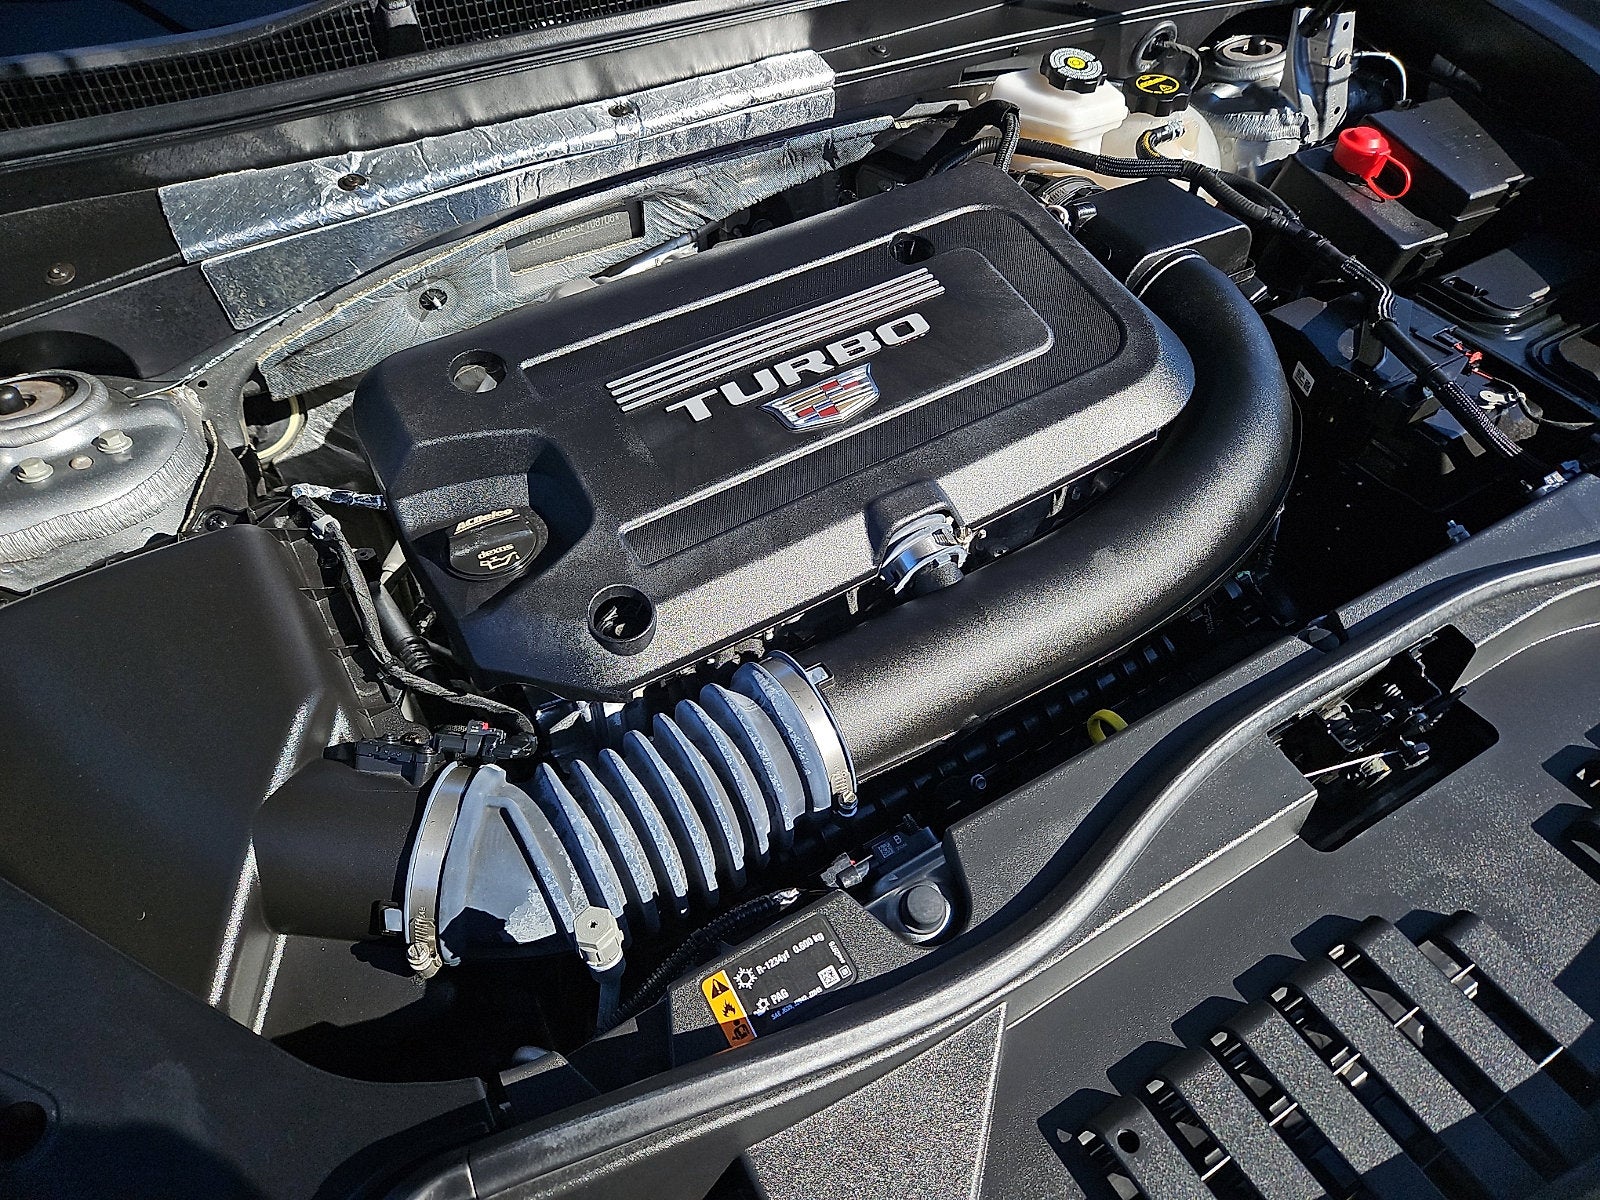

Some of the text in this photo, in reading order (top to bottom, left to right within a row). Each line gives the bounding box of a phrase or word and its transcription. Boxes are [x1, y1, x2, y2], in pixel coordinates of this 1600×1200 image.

[665, 313, 930, 422] TURBO
[455, 508, 513, 532] ACDelco
[478, 543, 514, 559] dexos
[755, 950, 791, 974] R-1234yf
[812, 932, 825, 943] kg
[770, 988, 789, 1004] PAG
